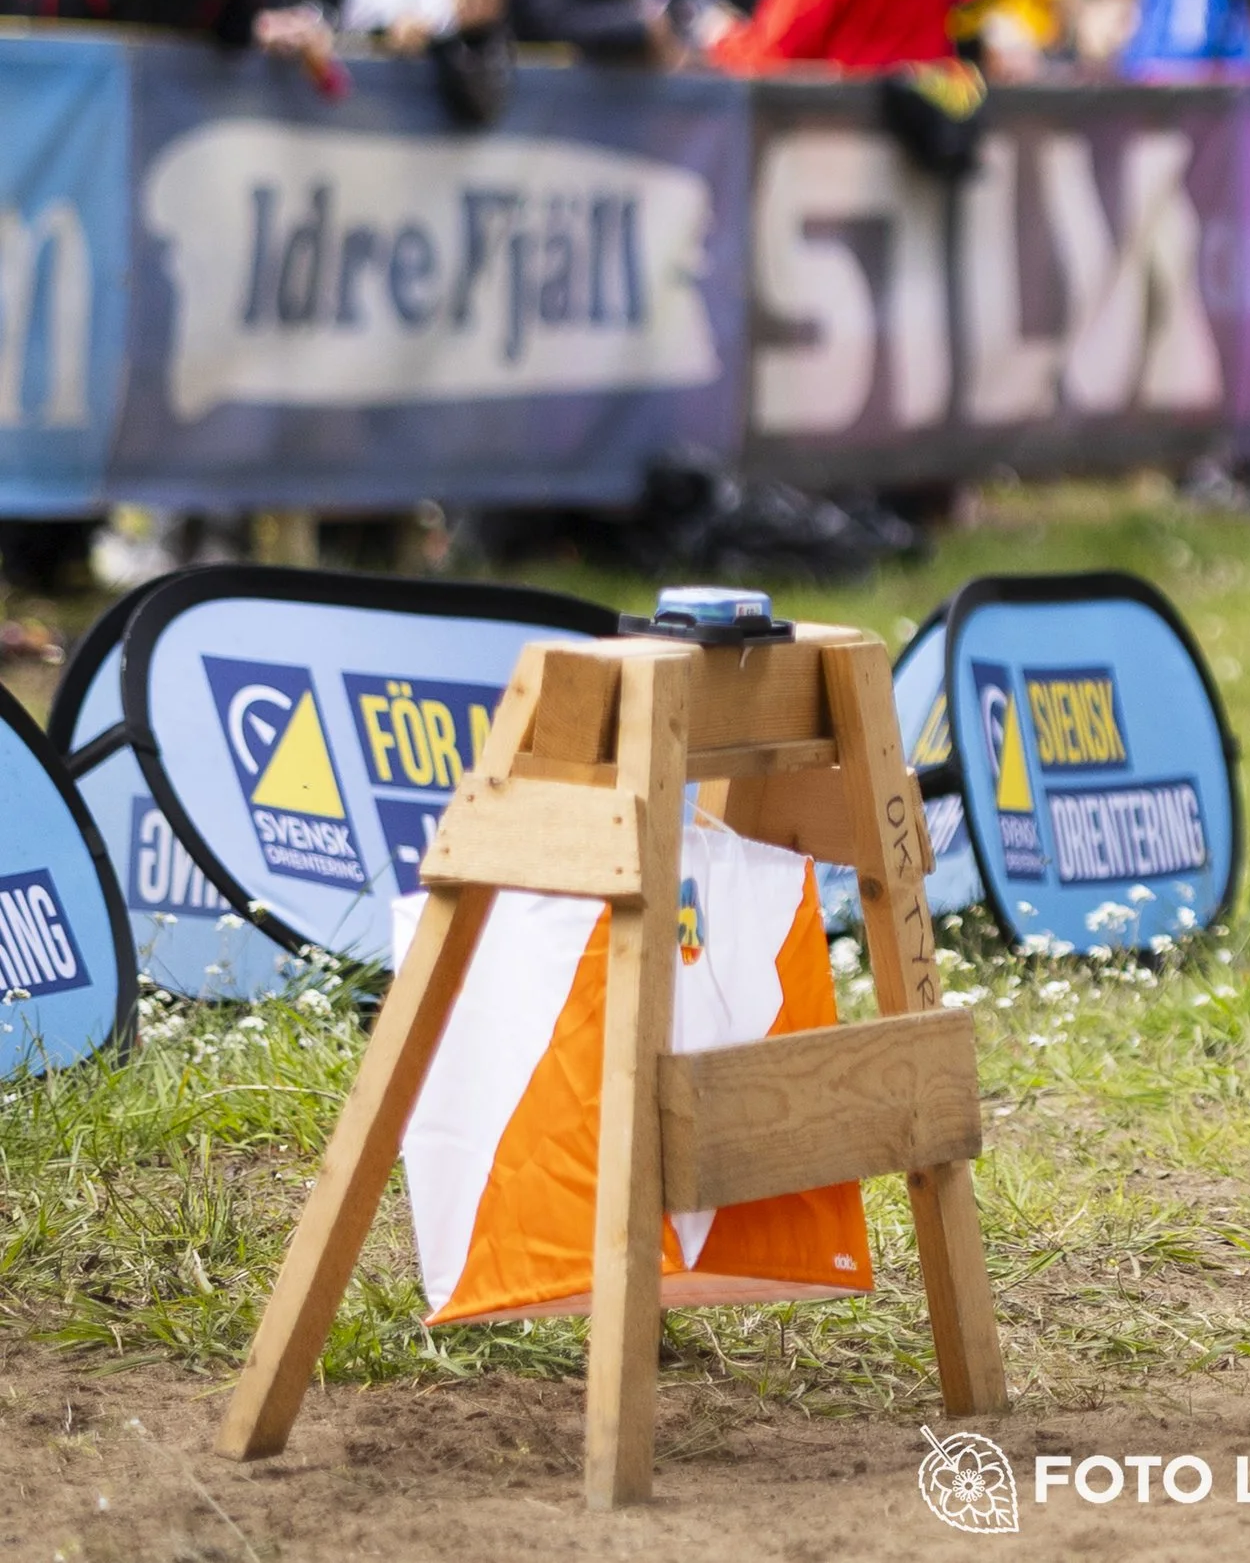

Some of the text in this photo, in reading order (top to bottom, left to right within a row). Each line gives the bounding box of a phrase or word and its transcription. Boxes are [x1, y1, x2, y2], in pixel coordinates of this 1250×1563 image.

[359, 679, 464, 787] FÖR
[1028, 679, 1127, 765] SVENSK
[253, 809, 357, 859] SVENSK
[886, 795, 912, 879] OK
[1051, 784, 1207, 882] ORIENTERING
